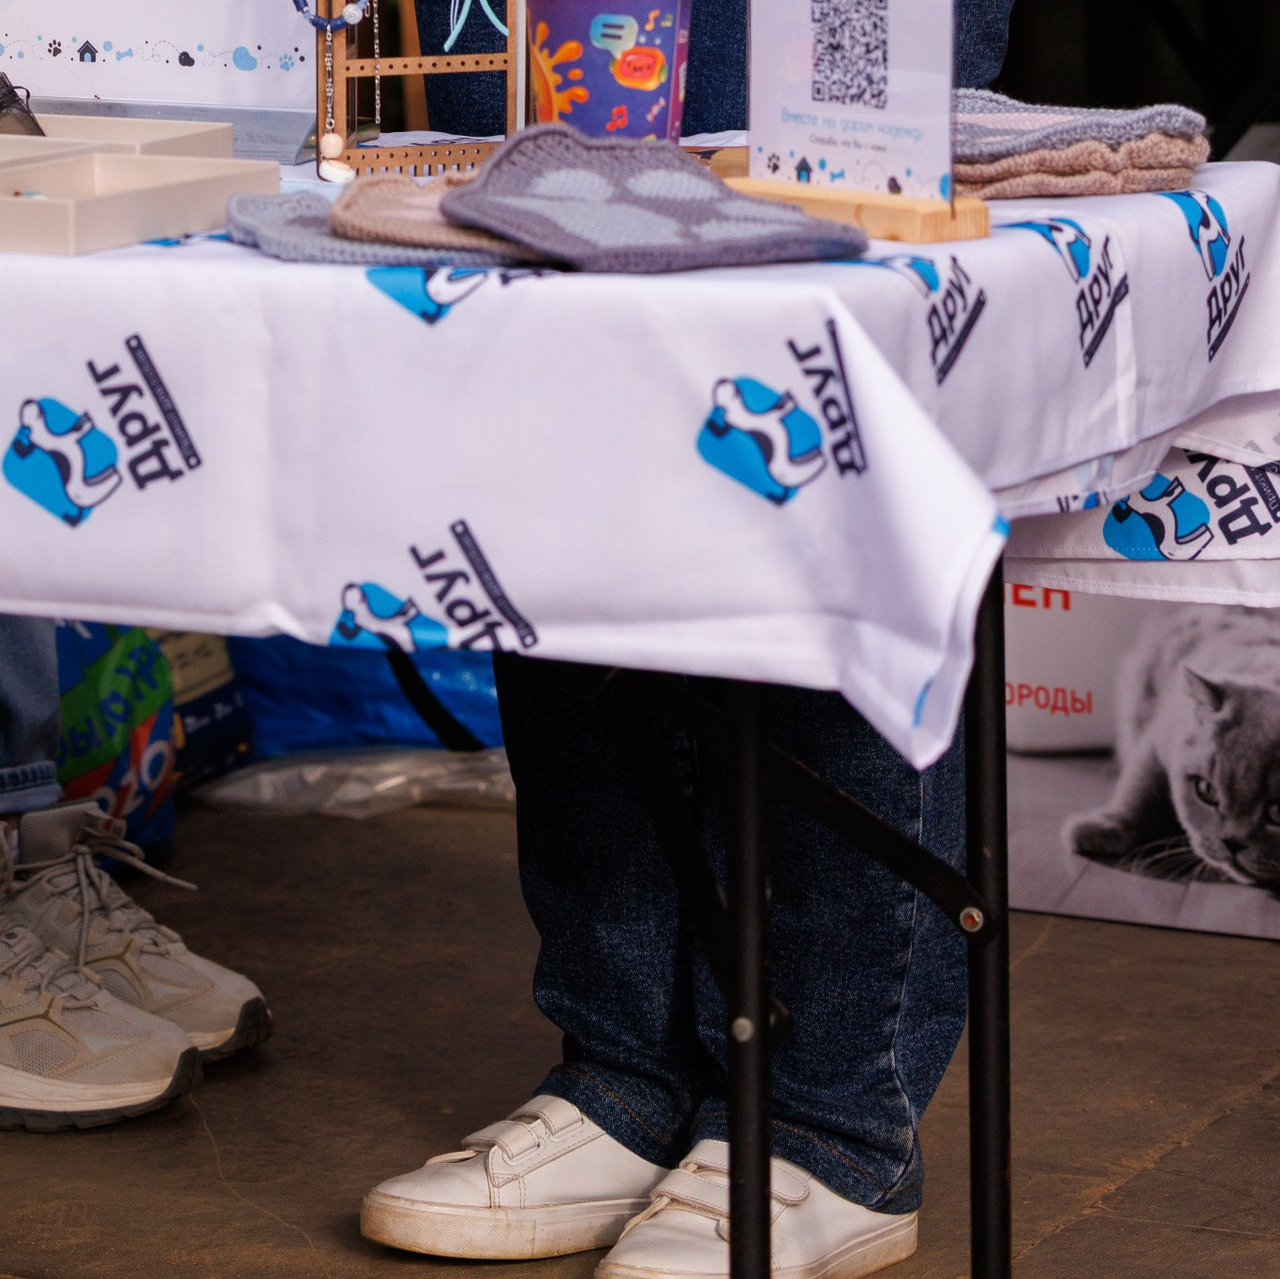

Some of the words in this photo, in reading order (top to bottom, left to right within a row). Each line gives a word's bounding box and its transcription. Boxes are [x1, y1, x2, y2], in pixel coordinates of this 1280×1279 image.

[927, 255, 971, 367] Друг
[1076, 234, 1114, 350] Друг
[1206, 234, 1246, 346] Друг
[86, 360, 185, 490] Друг
[1183, 448, 1273, 546] Дру
